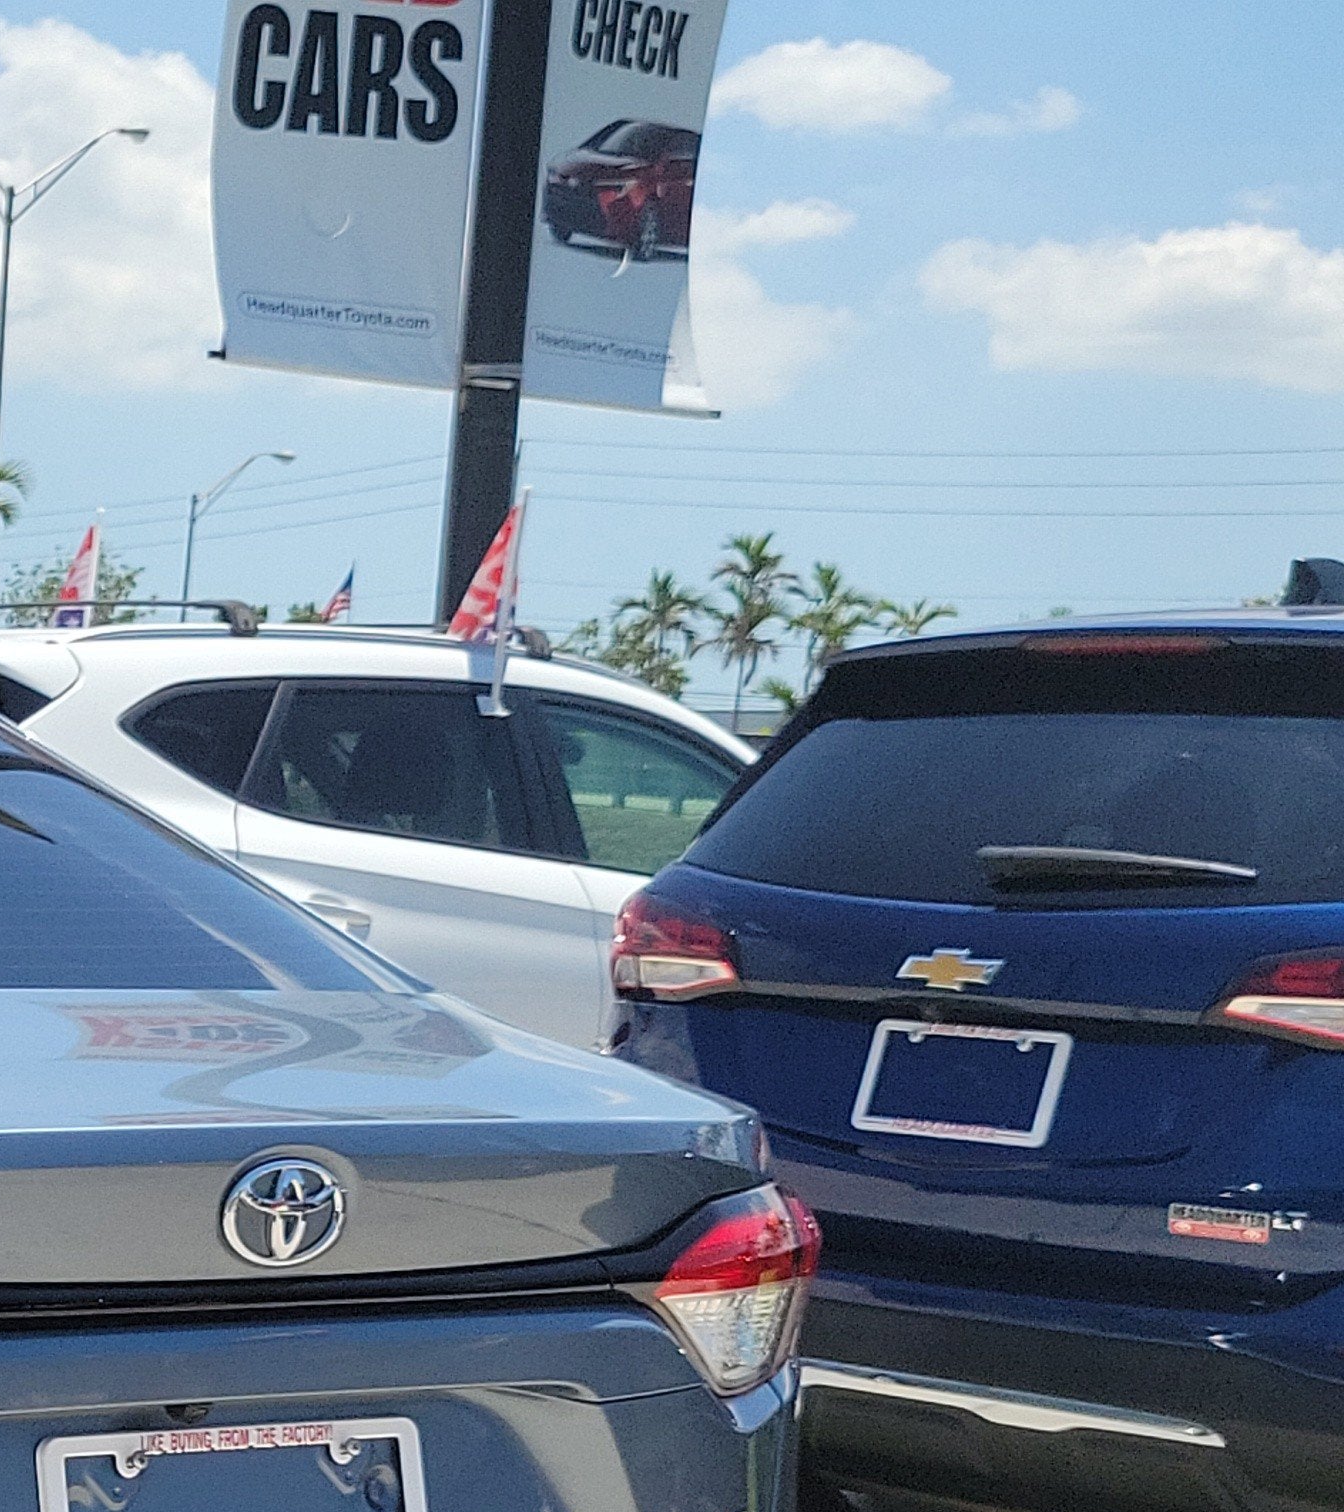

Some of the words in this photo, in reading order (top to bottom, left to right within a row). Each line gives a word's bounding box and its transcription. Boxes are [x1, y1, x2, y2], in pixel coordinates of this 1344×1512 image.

[572, 0, 689, 80] CHECK
[233, 4, 463, 143] CARS
[246, 297, 430, 330] HeadquarterToyota.com
[140, 1434, 163, 1451] LIKE
[170, 1431, 212, 1450] BUYING
[218, 1429, 250, 1447] FROM
